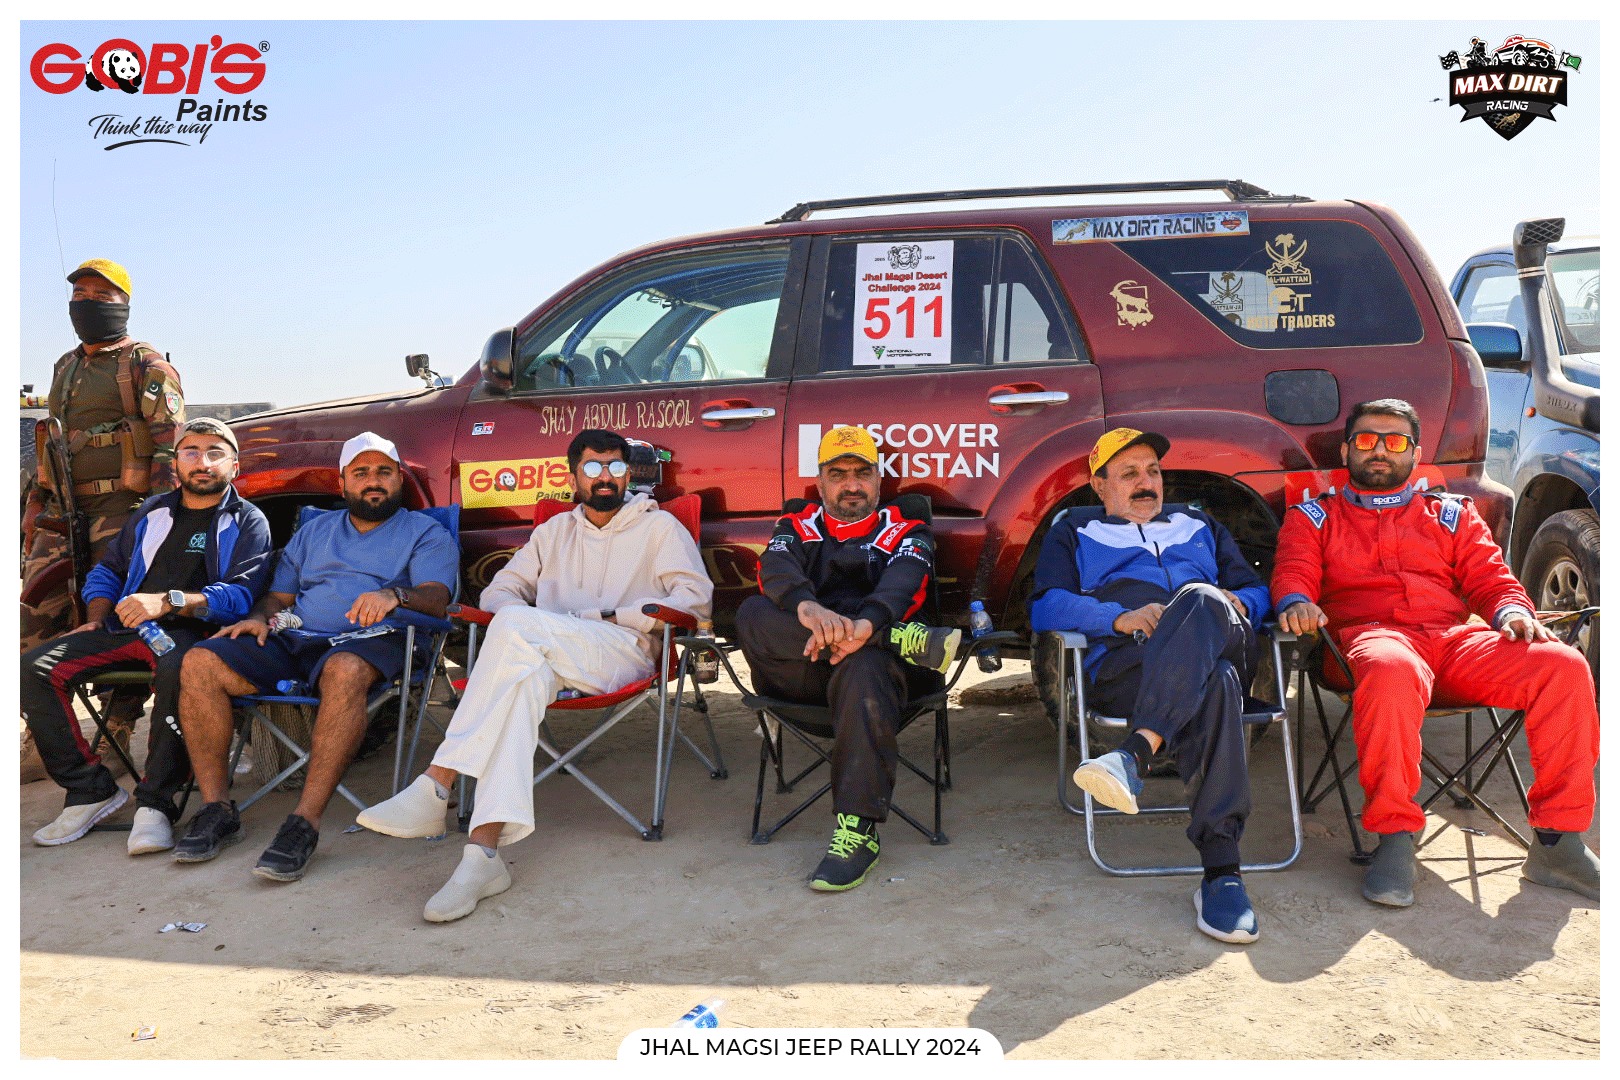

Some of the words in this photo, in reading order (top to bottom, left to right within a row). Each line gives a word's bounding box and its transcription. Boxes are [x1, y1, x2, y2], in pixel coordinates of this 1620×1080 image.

[1093, 220, 1124, 238] MAX
[1127, 219, 1160, 236] DIRT
[1163, 216, 1216, 235] RACING
[862, 273, 882, 281] Jhal
[885, 272, 913, 282] Magsi
[916, 271, 948, 280] Desert
[868, 284, 916, 293] Challenge
[918, 282, 941, 291] 2024
[863, 295, 943, 340] 511
[1281, 314, 1336, 328] TRADERS
[540, 405, 577, 436] SHAY
[582, 402, 630, 430] ABDUL
[636, 399, 695, 429] RASOOL
[833, 424, 999, 447] SCOVER
[879, 452, 999, 478] KISTAN
[1373, 496, 1401, 505] sparco
